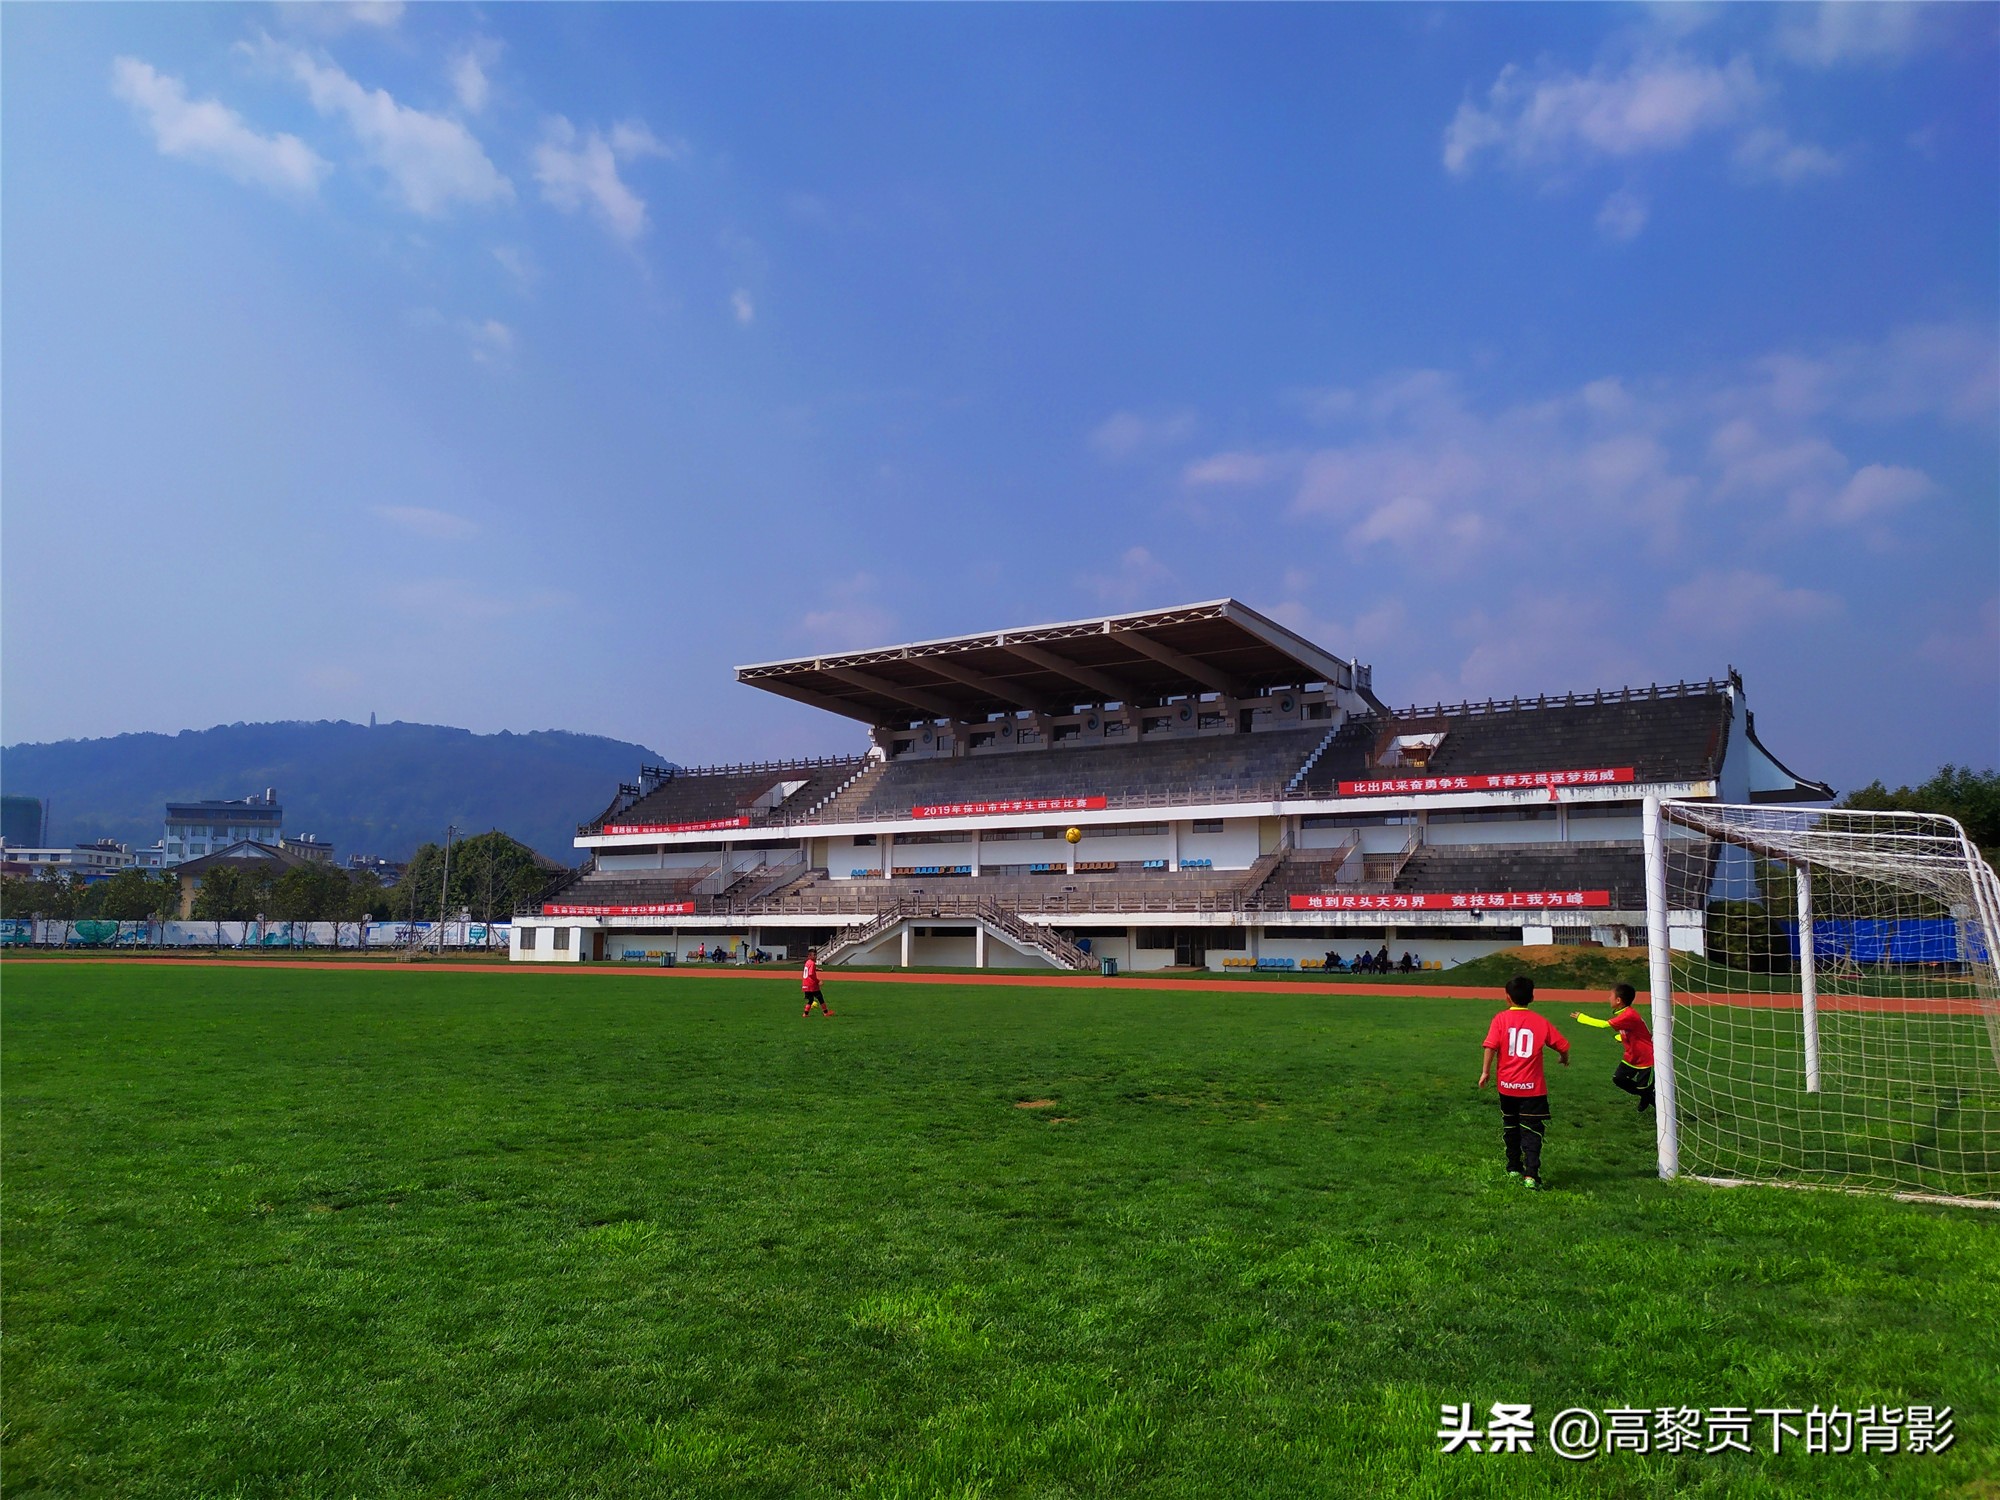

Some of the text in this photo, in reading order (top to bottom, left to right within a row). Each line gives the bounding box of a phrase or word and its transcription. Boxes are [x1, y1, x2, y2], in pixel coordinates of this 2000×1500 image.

[1353, 769, 1616, 793] 比出风采奋勇争先 青春无畏逐梦扬威
[923, 798, 1088, 816] 2019年保山市中学生田径比赛
[1308, 892, 1585, 907] 地到尽头天为界 竞技场上我为峰
[1508, 1027, 1534, 1059] 10
[1500, 1080, 1535, 1090] PANPASI
